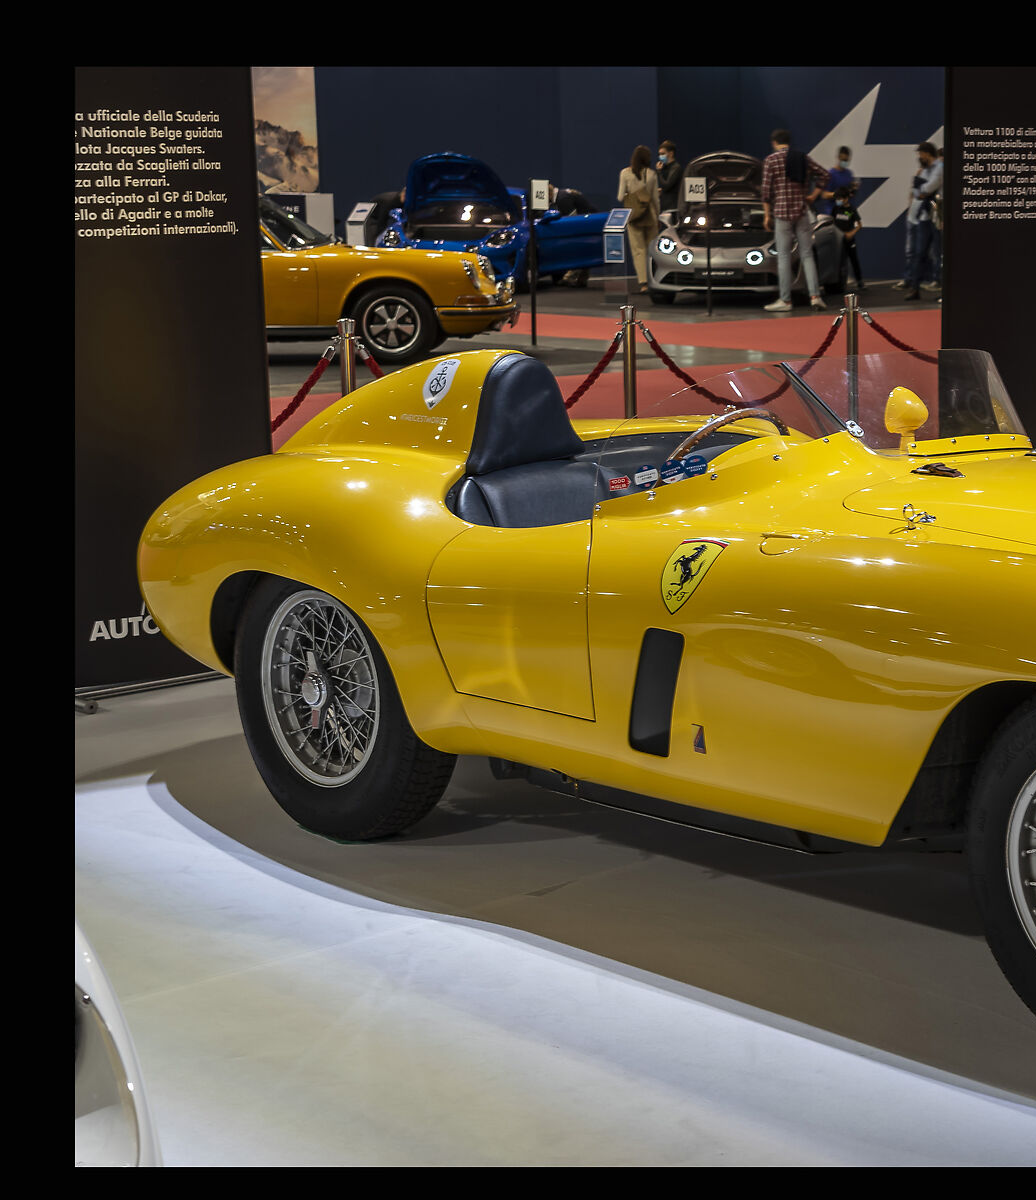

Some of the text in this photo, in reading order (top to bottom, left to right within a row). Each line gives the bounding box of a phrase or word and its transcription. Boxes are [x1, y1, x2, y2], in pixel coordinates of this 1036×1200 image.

[88, 109, 140, 121] ufficiale
[143, 110, 173, 122] della
[176, 110, 219, 122] Scuderia
[81, 126, 147, 138] Nationale
[150, 126, 182, 140] Belge
[185, 126, 223, 140] guidata
[963, 127, 994, 136] Vettura
[995, 127, 1015, 136] 1100
[1016, 127, 1024, 136] di
[75, 142, 205, 157] lota Jacques Swaters.
[963, 140, 975, 148] un
[963, 151, 975, 160] ha
[976, 151, 1020, 161] partecipato
[116, 159, 133, 171] da
[137, 159, 189, 173] Scaglietti
[192, 158, 221, 170] allora
[963, 162, 984, 172] della
[986, 163, 1007, 172] 1000
[95, 175, 121, 188] alla
[124, 175, 170, 187] Ferrari.
[148, 191, 159, 203] al
[163, 191, 179, 203] GP
[182, 190, 193, 202] di
[195, 190, 228, 204] Dakar,
[963, 187, 995, 196] Madero
[963, 199, 1012, 209] pseudonimo
[1013, 198, 1025, 207] del
[101, 208, 114, 220] di
[118, 207, 161, 222] Agadir
[164, 209, 172, 218] e
[175, 209, 183, 218] a
[185, 206, 214, 218] molte
[963, 211, 988, 219] driver
[989, 210, 1012, 219] Bruno
[78, 221, 239, 239] competizioni internazionali).
